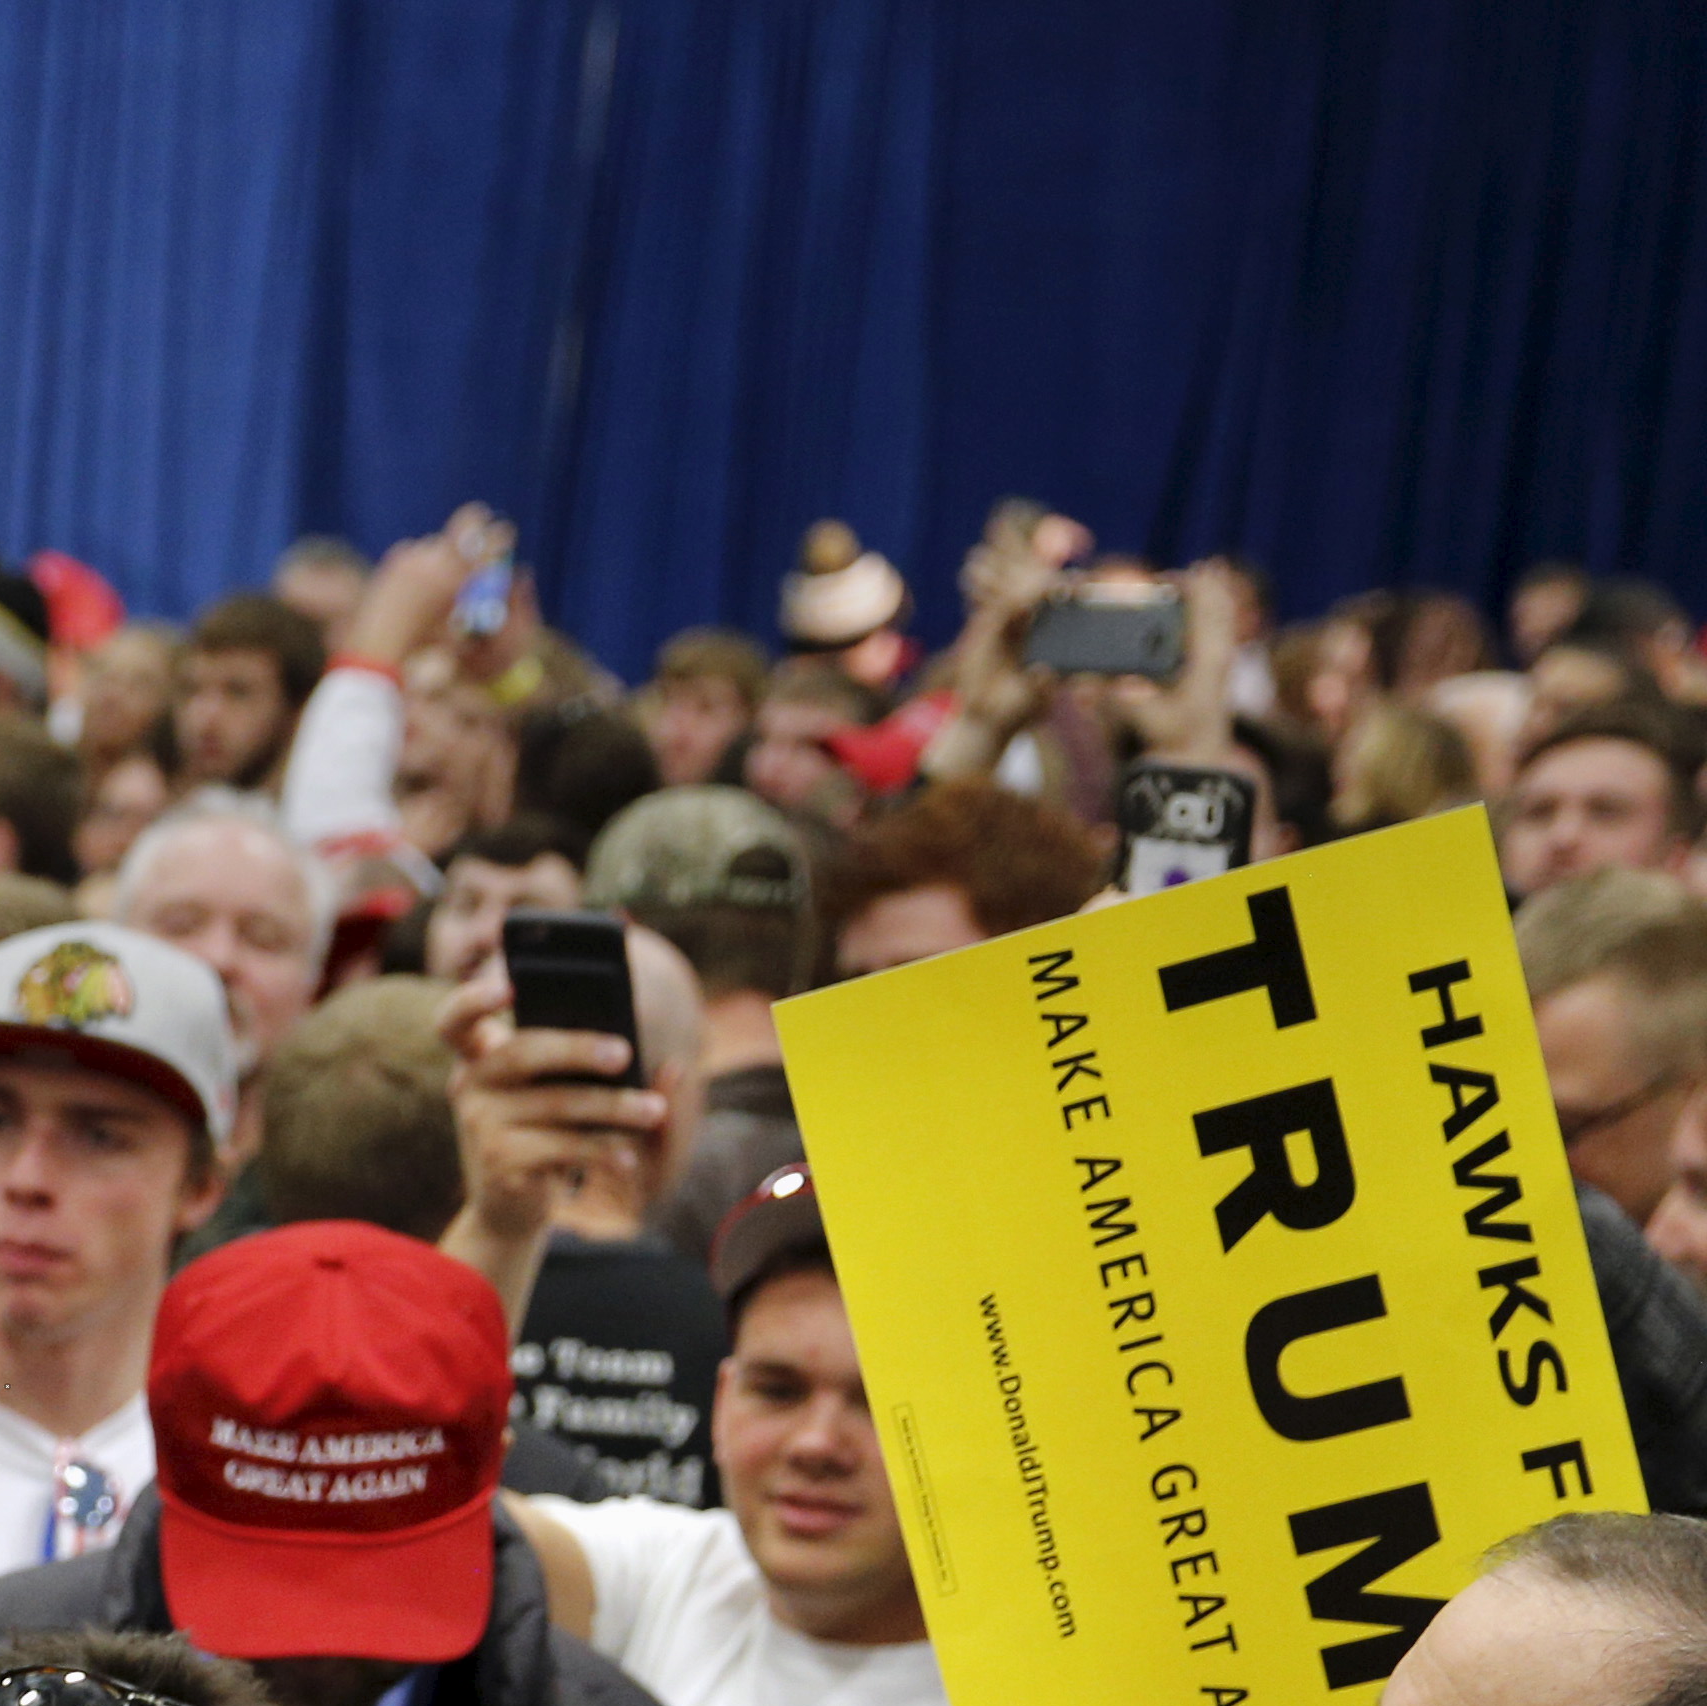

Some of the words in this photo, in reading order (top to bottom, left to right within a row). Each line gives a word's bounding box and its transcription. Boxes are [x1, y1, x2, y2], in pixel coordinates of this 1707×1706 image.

[1027, 949, 1111, 1131] MAKE
[1074, 1157, 1182, 1442] AMERICA
[1150, 1463, 1238, 1652] GREAT
[1159, 884, 1449, 1692] TRUM
[1407, 959, 1568, 1408] HAWKS
[210, 1417, 299, 1463] MAKE
[299, 1427, 445, 1465] AMERICA
[223, 1459, 329, 1501] GREAT
[326, 1463, 429, 1503] AGAIN
[979, 1292, 1076, 1638] www.DonaldJTrump.com
